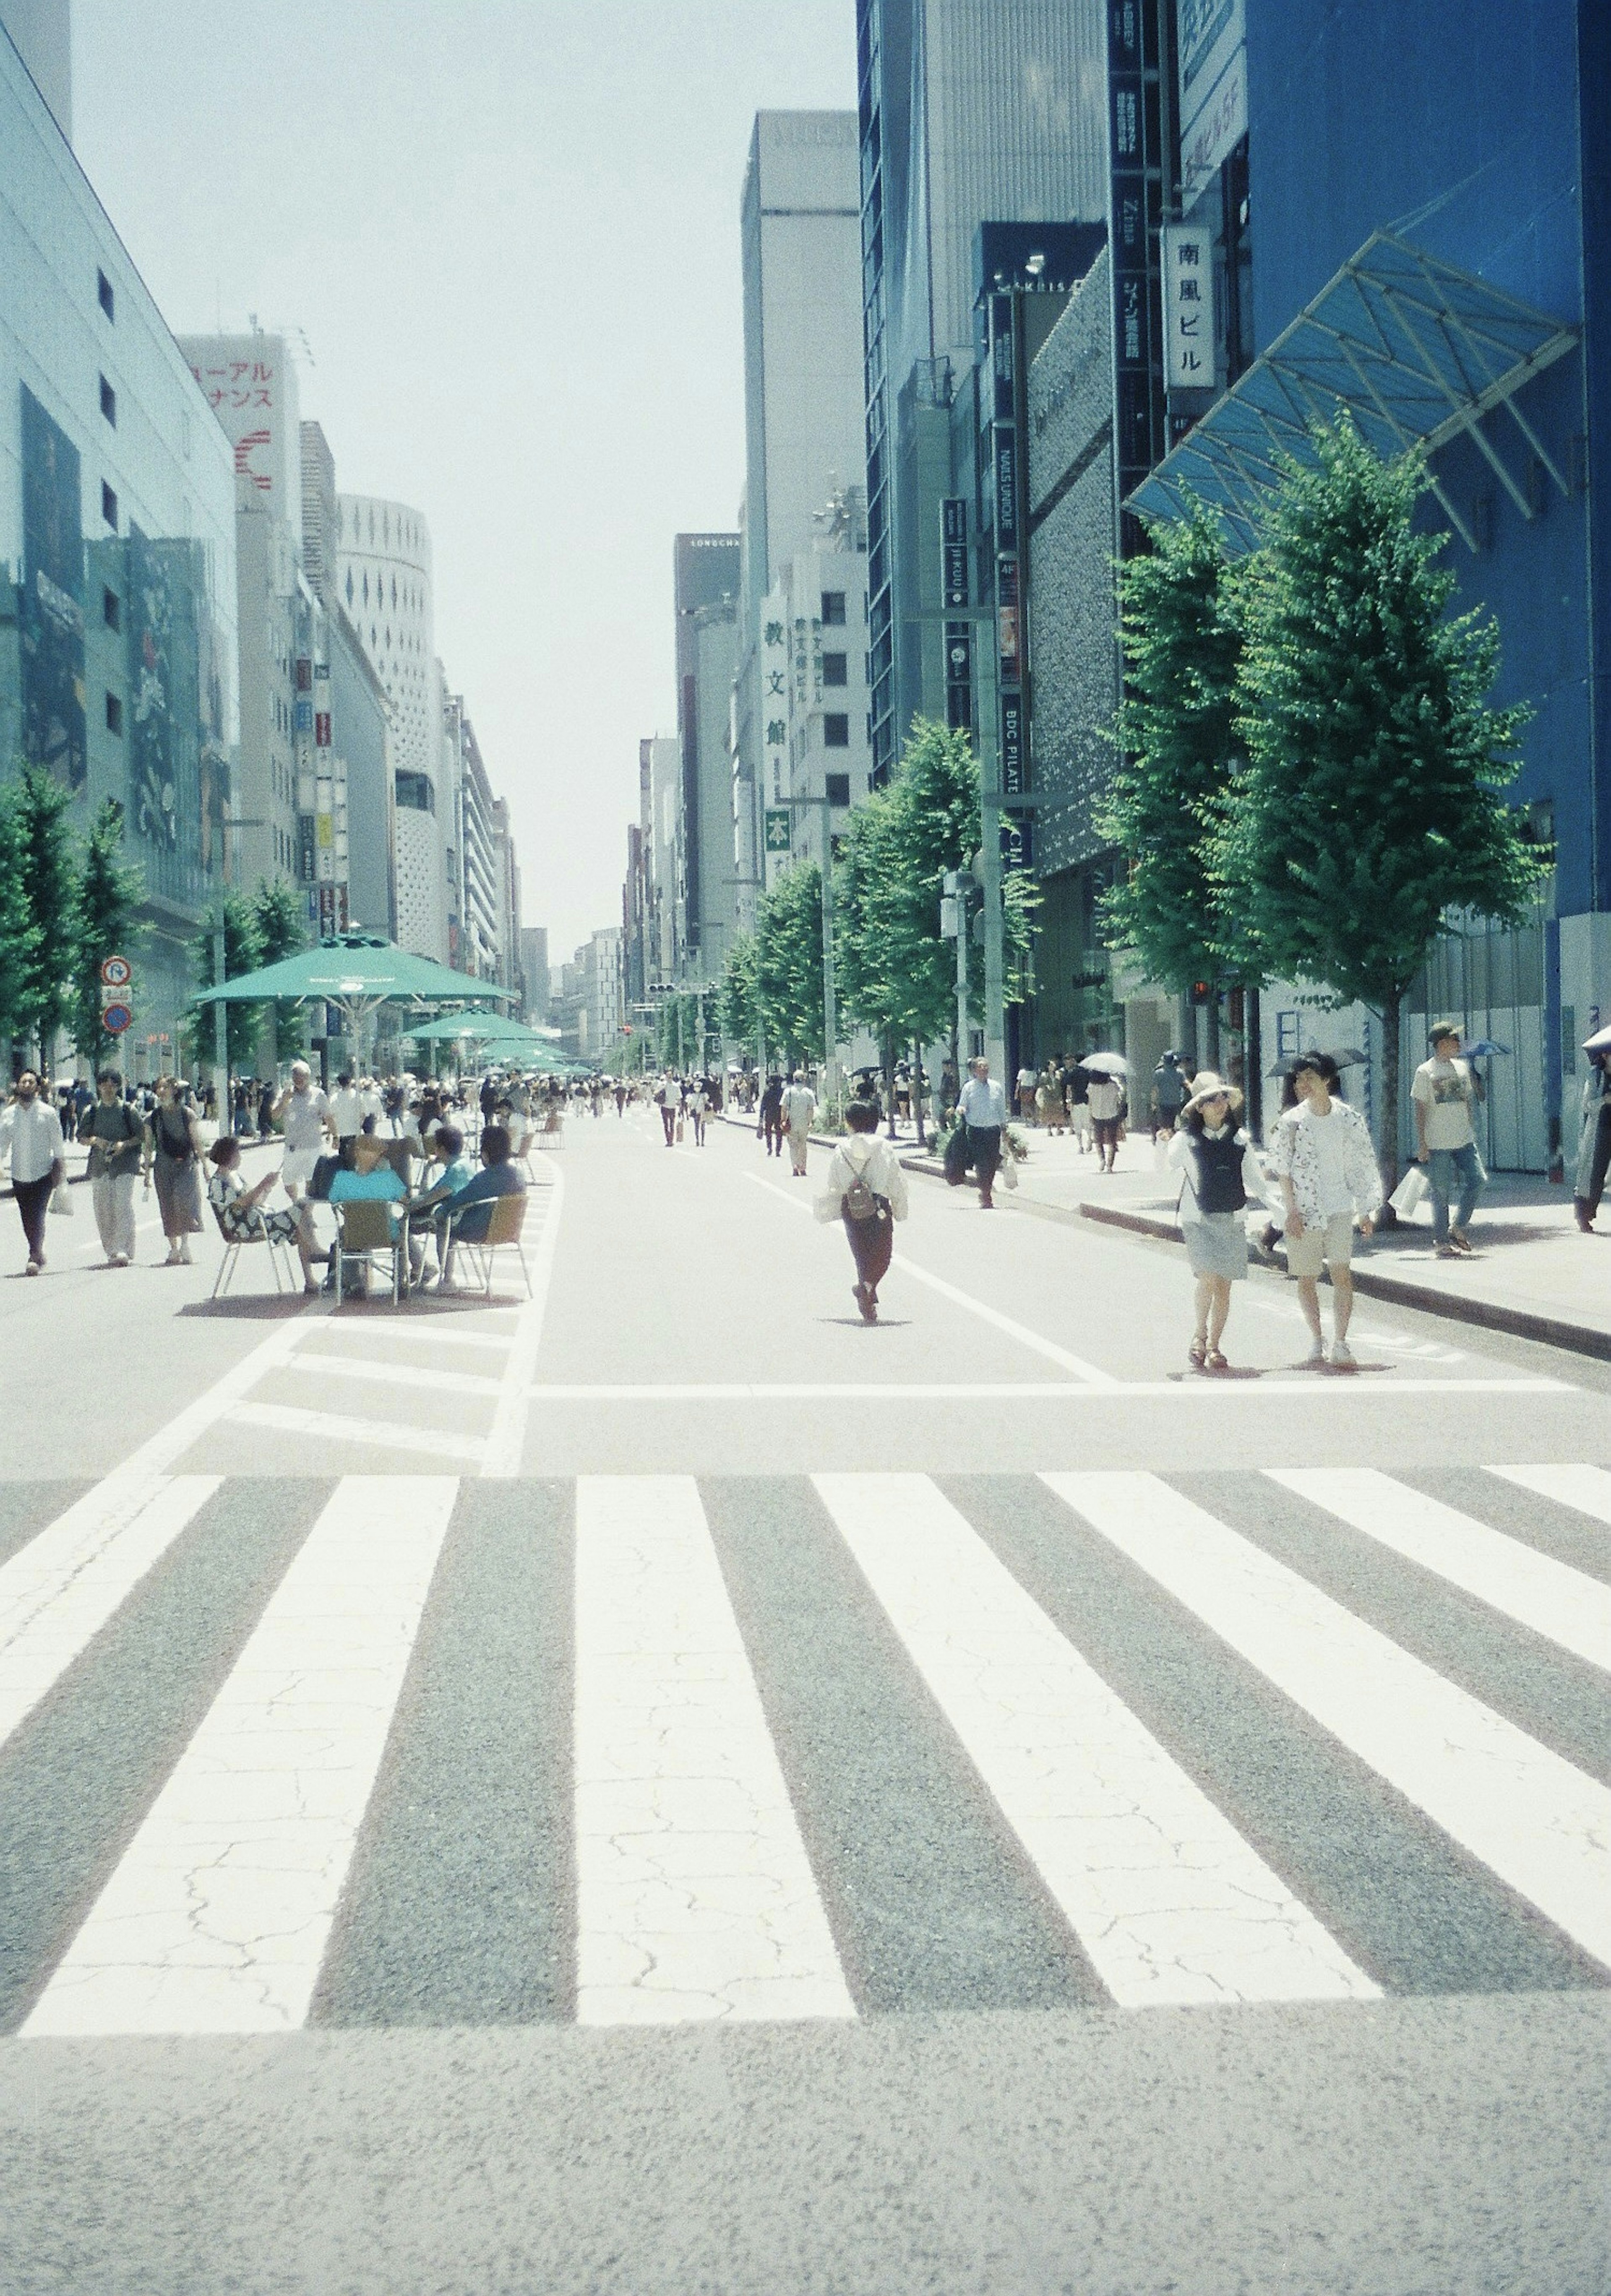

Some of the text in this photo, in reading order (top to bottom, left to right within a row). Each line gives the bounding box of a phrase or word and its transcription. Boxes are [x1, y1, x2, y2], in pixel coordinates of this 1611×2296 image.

[1178, 243, 1201, 371] 南風ビル
[191, 362, 273, 383] ューアル
[209, 389, 273, 409] ナンス
[690, 539, 740, 547] LONGCHA
[764, 620, 785, 746] 教文館
[1006, 711, 1019, 794] BDC PILATE
